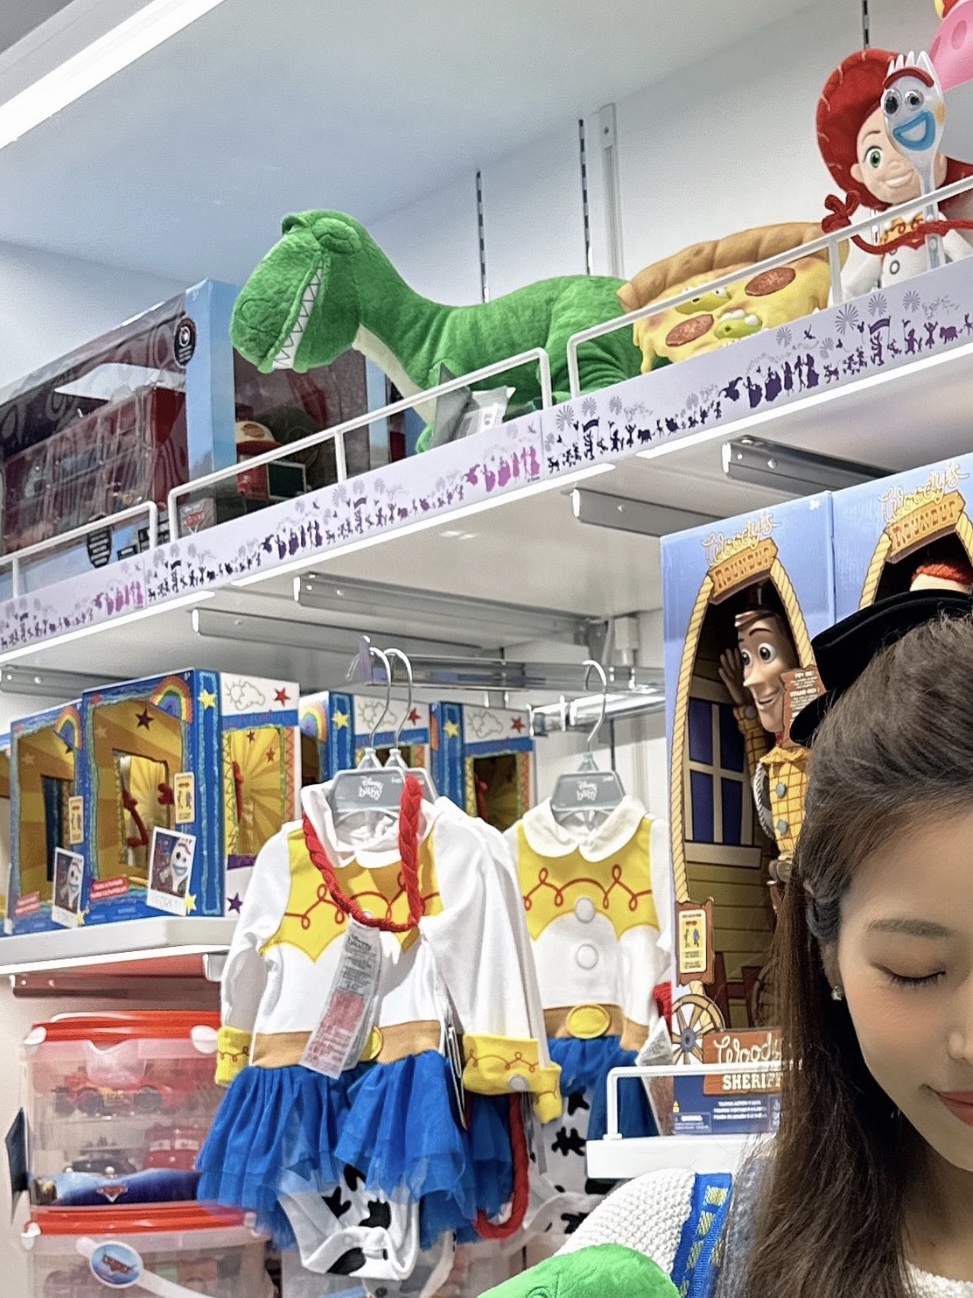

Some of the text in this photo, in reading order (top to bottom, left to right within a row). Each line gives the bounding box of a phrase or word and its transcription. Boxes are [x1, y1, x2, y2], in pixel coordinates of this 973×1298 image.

[877, 460, 970, 524] Woody's
[702, 510, 782, 567] Woody's
[892, 499, 956, 548] ROUNDUP
[714, 545, 771, 589] ROUNDUP
